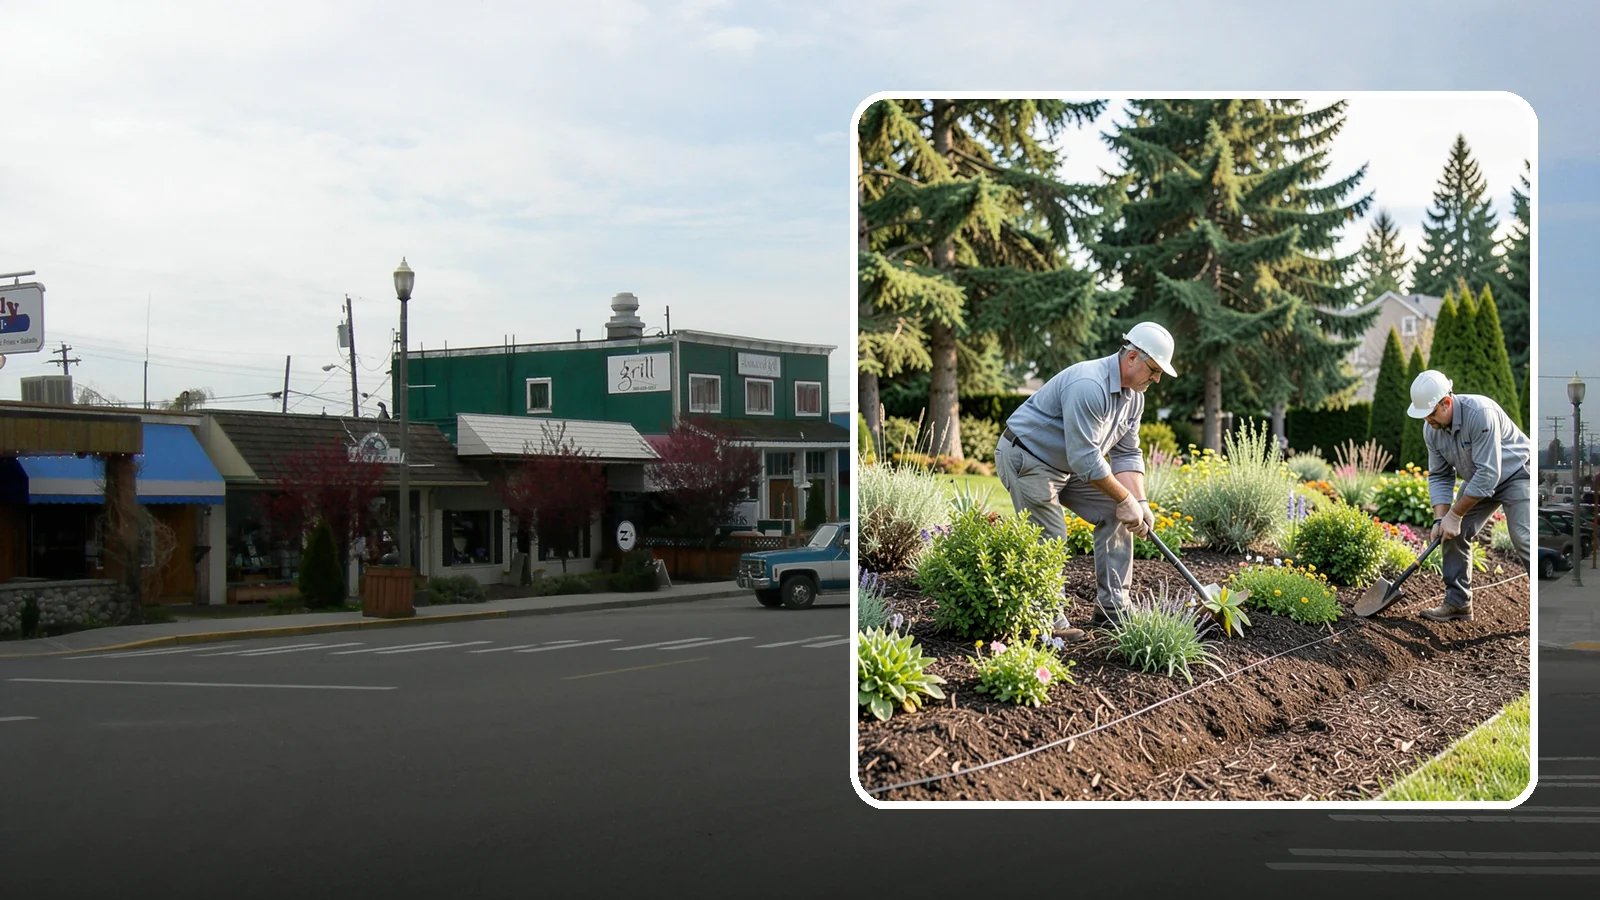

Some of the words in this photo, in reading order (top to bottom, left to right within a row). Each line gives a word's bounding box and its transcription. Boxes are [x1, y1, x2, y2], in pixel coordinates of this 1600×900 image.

[0, 297, 19, 324] ly
[3, 338, 16, 346] Fries
[20, 337, 38, 345] Salads
[618, 356, 655, 391] grill
